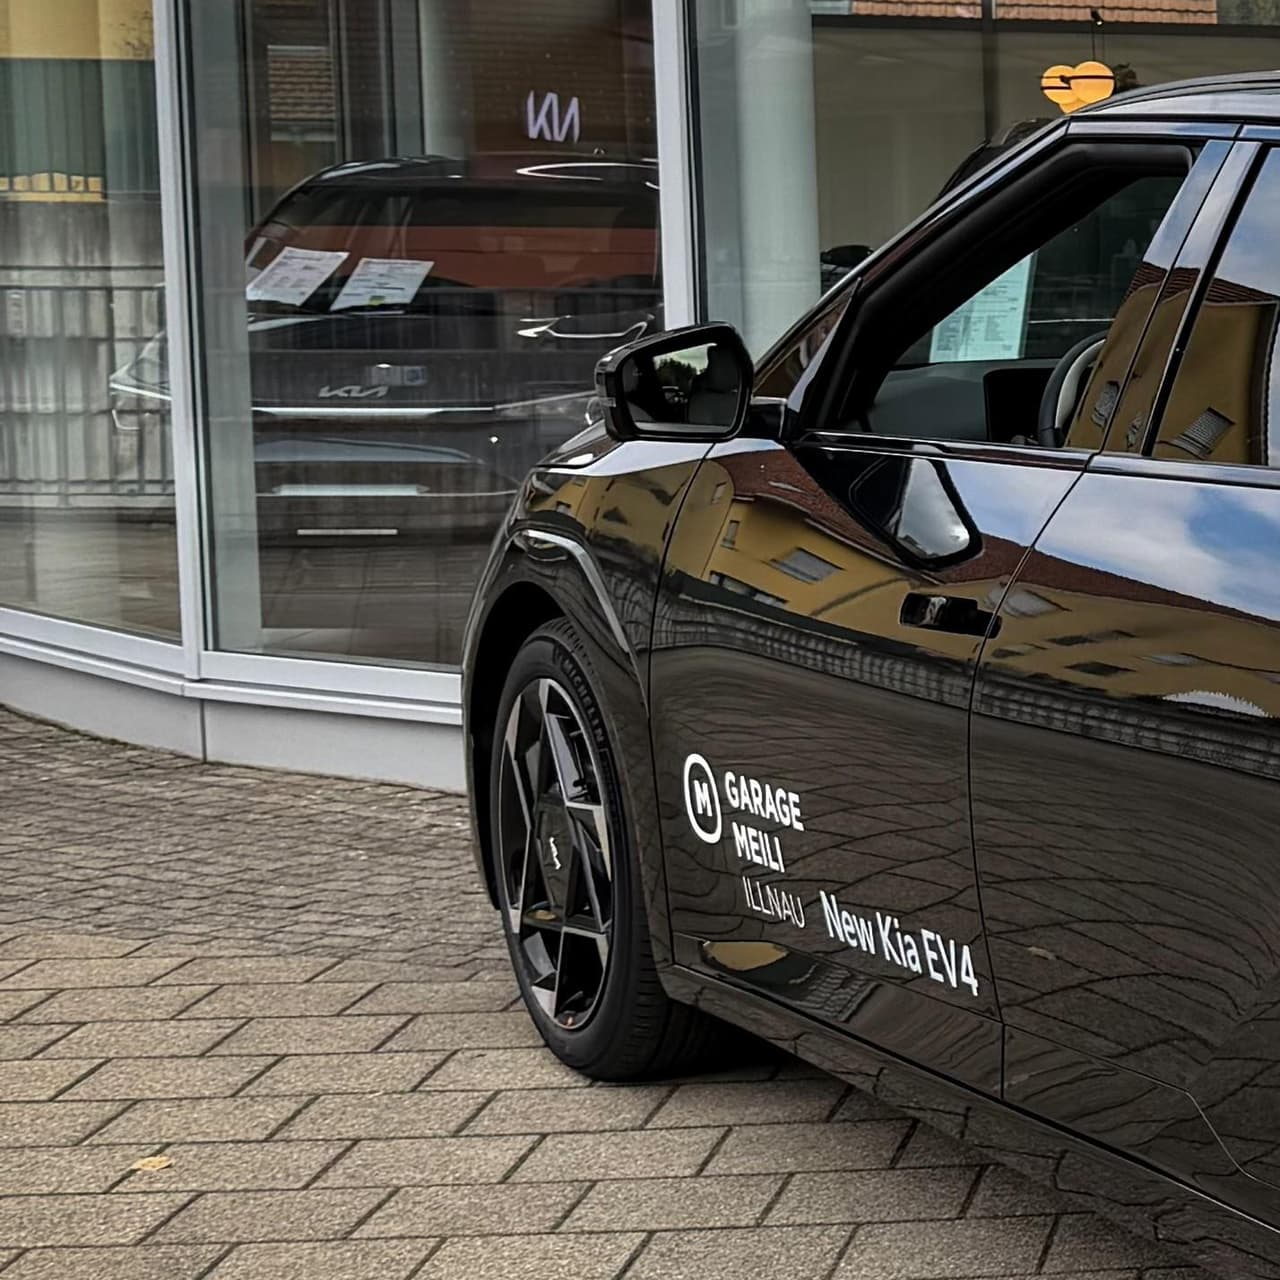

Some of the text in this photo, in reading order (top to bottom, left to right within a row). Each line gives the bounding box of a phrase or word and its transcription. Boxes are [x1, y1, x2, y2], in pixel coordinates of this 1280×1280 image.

[724, 771, 805, 832] GARAGE
[732, 821, 786, 873] MEILI
[742, 876, 806, 929] ILLNAU
[819, 890, 980, 997] New Kia EV4
